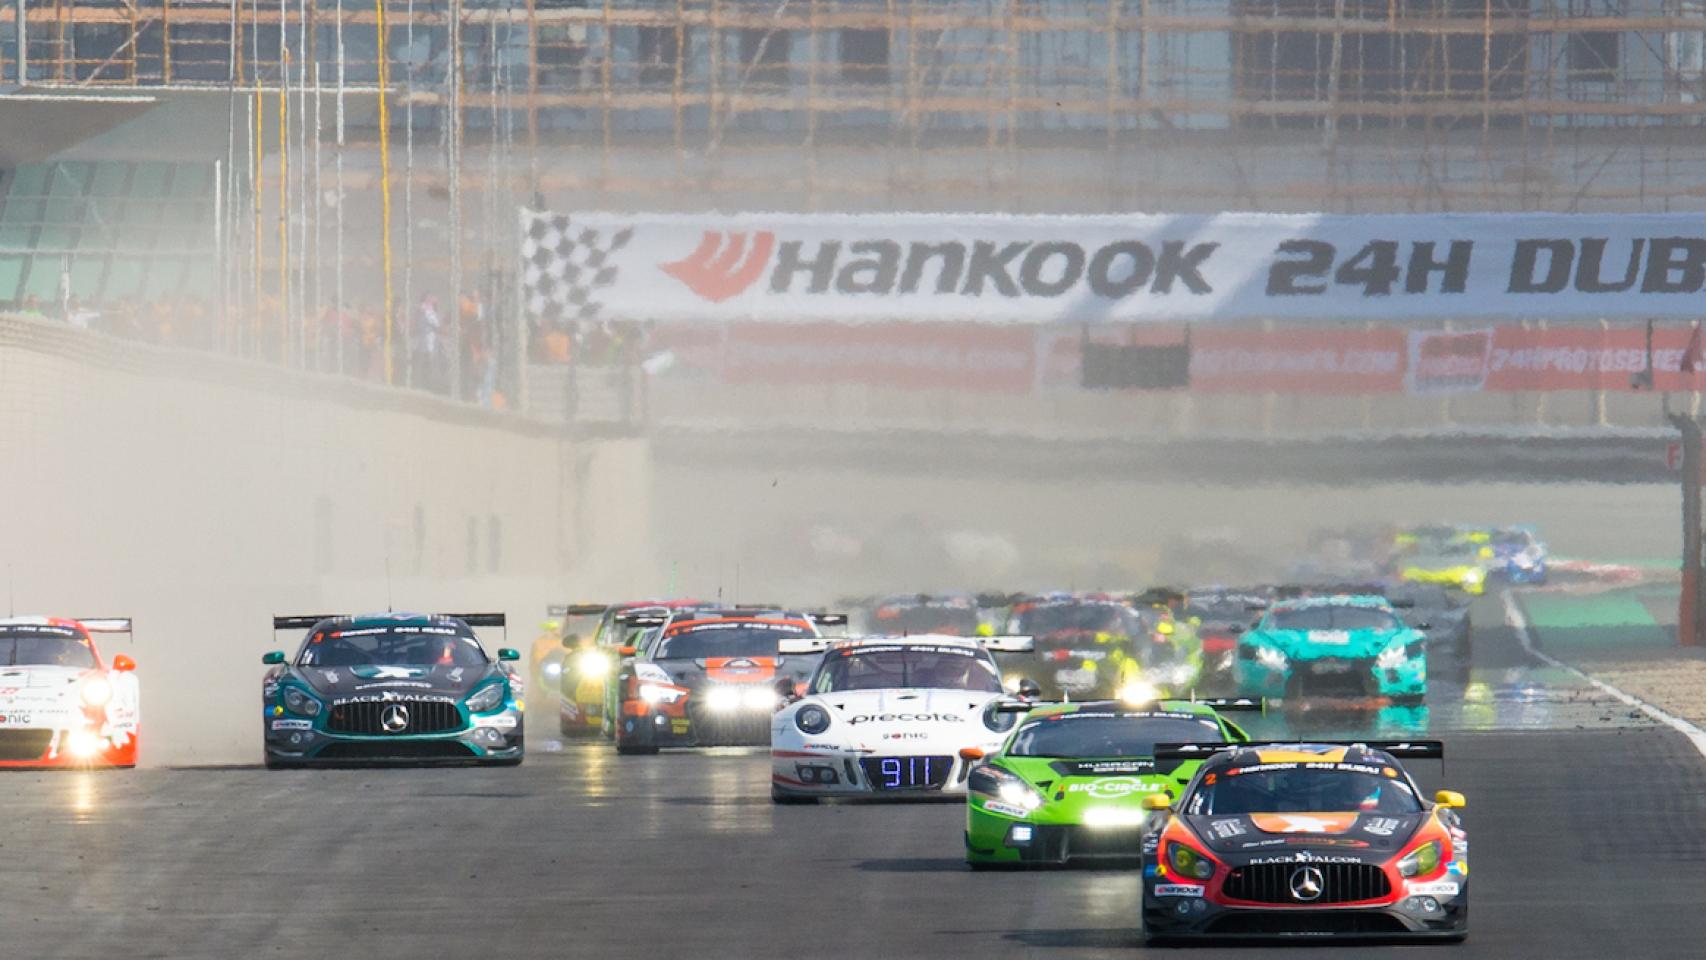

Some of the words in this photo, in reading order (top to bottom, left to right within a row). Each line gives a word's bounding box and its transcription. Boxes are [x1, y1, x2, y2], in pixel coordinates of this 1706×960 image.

[1265, 237, 1474, 297] 24H
[333, 695, 380, 705] BLACK
[397, 694, 455, 703] FALCON
[881, 757, 931, 788] 911
[1204, 773, 1217, 785] 2
[1068, 782, 1161, 793] BIO-CIRCLE
[1249, 856, 1295, 865] BLACK
[1308, 855, 1362, 864] FALCON
